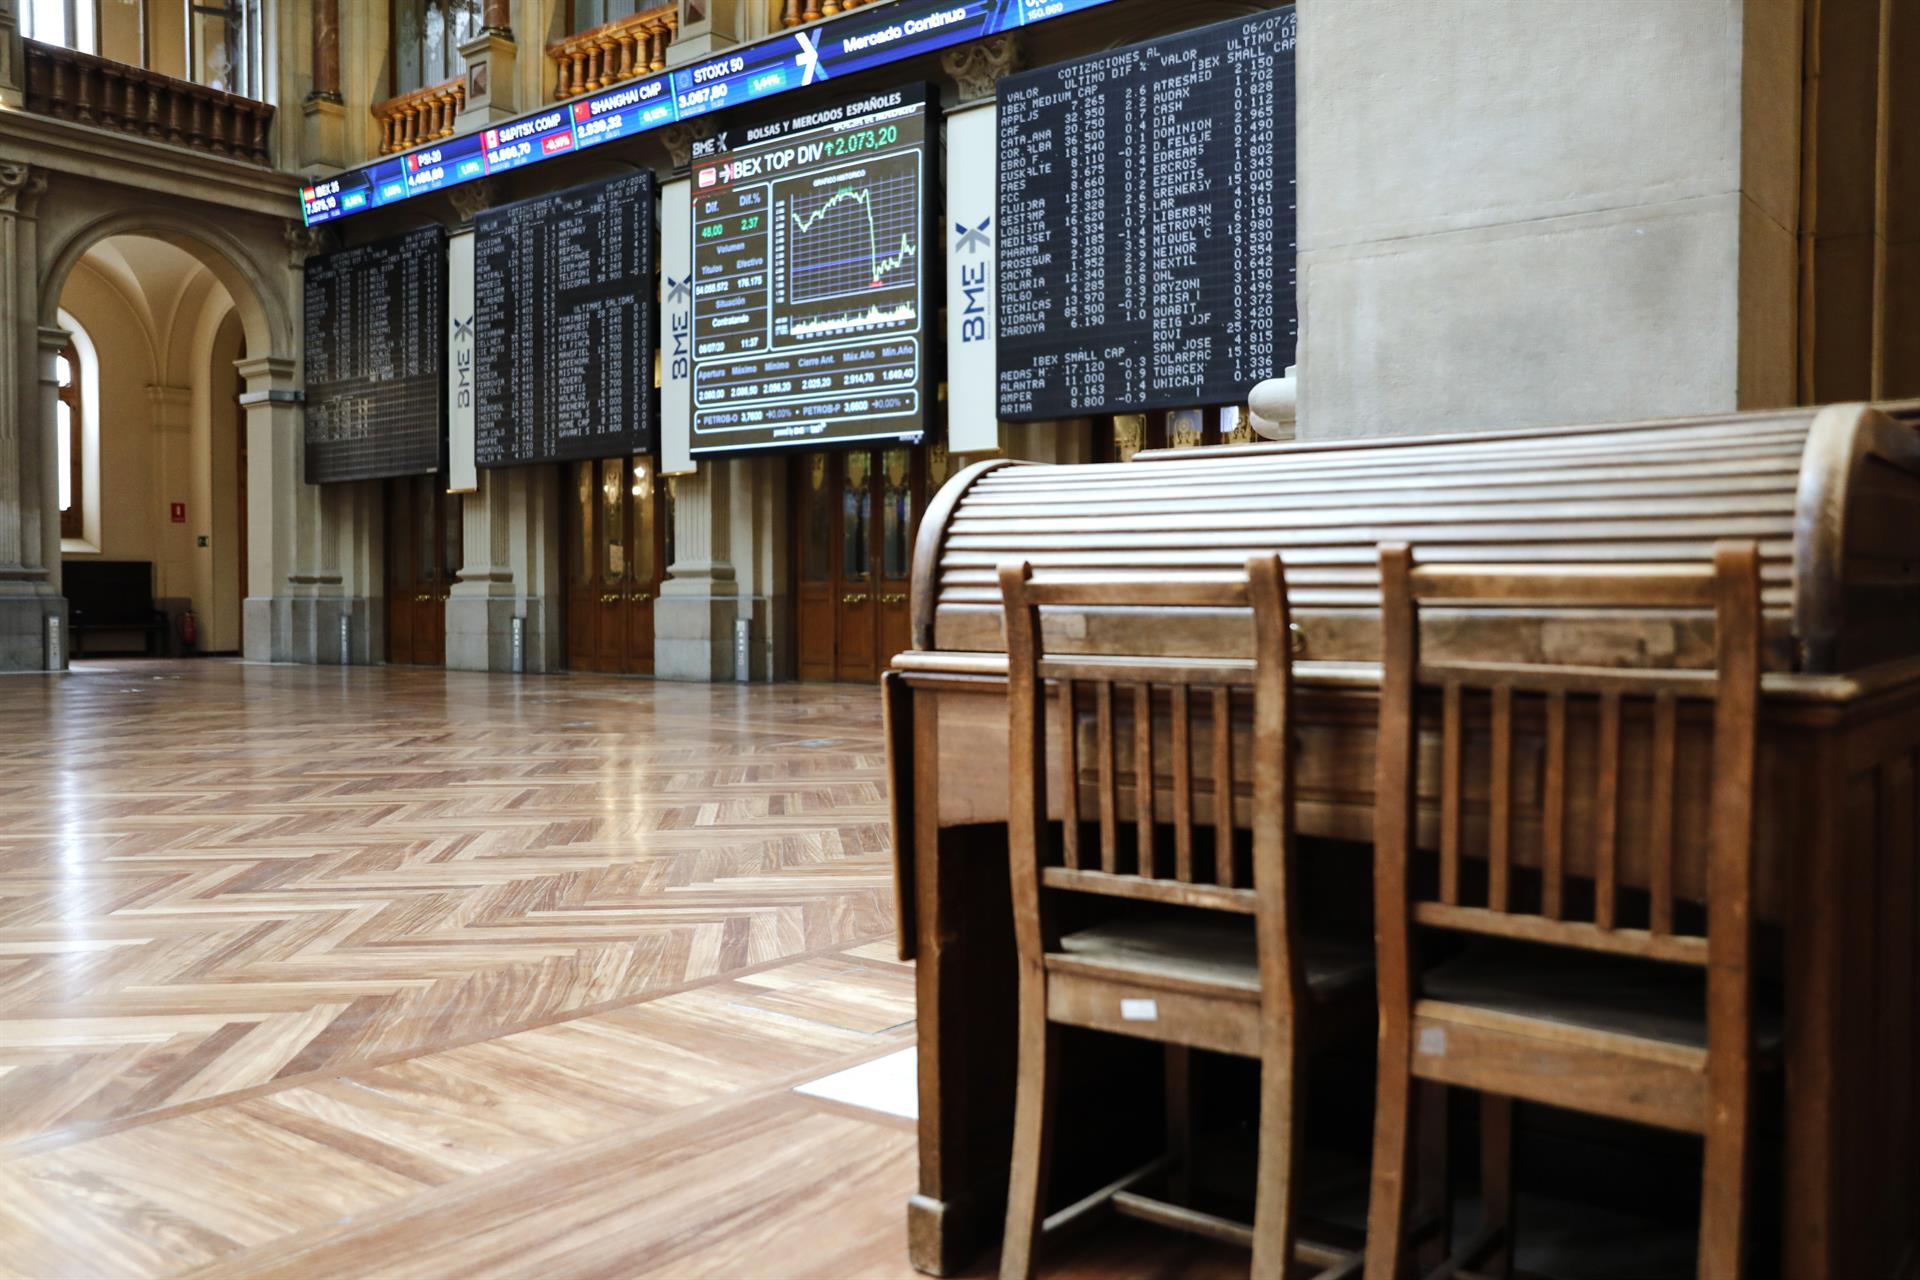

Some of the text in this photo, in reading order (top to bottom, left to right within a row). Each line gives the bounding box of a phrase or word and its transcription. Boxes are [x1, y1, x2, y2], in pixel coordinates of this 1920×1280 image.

[843, 8, 967, 54] Mercado Continuo
[1160, 50, 1196, 67] VALOR
[1227, 32, 1273, 52] ULTIMO
[1227, 39, 1296, 64] SMALL CAP
[693, 56, 744, 83] STOXX 50
[1058, 46, 1160, 79] COTIZACIONES AL
[1234, 57, 1273, 75] 2.150
[1007, 86, 1038, 102] VALOR
[1064, 71, 1104, 89] ULTIMO
[1111, 65, 1131, 78] DIF
[1153, 69, 1272, 104] AUDAX 1.702
[590, 81, 662, 115] SHANGHAI CMP
[1002, 84, 1097, 114] IBEX MEDIUM CAP
[1071, 94, 1104, 110] 7.265
[1153, 82, 1272, 116] CASH 0.828
[747, 123, 780, 141] BOLSAS
[783, 121, 789, 132] Y
[792, 107, 843, 130] MERCADOS
[846, 92, 902, 117] ESPAÑOLES
[1001, 106, 1104, 137] CAF 32.950
[1153, 94, 1272, 128] DIA 0.112
[534, 113, 561, 132] COMP
[1064, 117, 1104, 135] 20.750
[1153, 107, 1273, 140] DOMINION 2.965
[1234, 119, 1273, 136] 0.490
[692, 138, 715, 156] BME
[835, 125, 897, 156] 2.073,20
[1064, 129, 1104, 146] 36.500
[1234, 132, 1272, 149] 2.440
[764, 149, 795, 172] TOP
[797, 142, 824, 165] DIV
[1001, 156, 1025, 170] EBRO
[1065, 141, 1104, 157] 18.540
[1153, 144, 1272, 176] ERCROS 1.802
[1153, 157, 1272, 187] EZENTIS 0.343
[1228, 169, 1272, 186] 15.000
[1001, 179, 1025, 192] FAES
[705, 201, 720, 214] Dif.
[1000, 191, 1019, 203] FCC
[1153, 198, 1174, 211] LAR
[1234, 194, 1271, 210] 0.161
[741, 216, 759, 231] 2,37
[1234, 207, 1272, 222] 6.190
[1153, 219, 1272, 247] MIQUEL C 12.980
[716, 242, 745, 255] Volumen
[1001, 244, 1038, 259] PHARMA
[1153, 231, 1272, 259] NEINOR 9.530
[736, 257, 763, 270] Efectivo
[1001, 245, 1104, 270] PROSEGUR 2.230
[1153, 244, 1272, 270] NEXTIL 0.554
[1001, 268, 1032, 281] SACYR
[1153, 256, 1272, 282] OHL 0.642
[1234, 269, 1272, 284] 3.150
[1000, 277, 1044, 292] SOLARIA
[962, 262, 985, 343] BME
[1001, 290, 1032, 303] TALGO
[1001, 291, 1104, 314] TECNICAS 13.970
[1153, 292, 1189, 306] PRISA
[1153, 294, 1272, 318] QUABIT 0.372
[712, 314, 750, 328] Contratando
[1001, 311, 1044, 325] VIDRALA
[1153, 306, 1272, 330] REIG 3.420
[1000, 322, 1044, 336] ZARDOYA
[1153, 319, 1272, 342] ROVI 25.700
[672, 311, 688, 380] BME
[1153, 331, 1272, 353] SAN JOSE 4.815
[1033, 347, 1124, 366] IBEX SMALL CAP
[1153, 344, 1272, 365] SOLARPAC 15.500
[1065, 361, 1104, 374] 17.120
[1153, 356, 1272, 377] TUBACEX 1.336
[1234, 368, 1272, 382] 0.495
[458, 349, 471, 409] BME
[1001, 373, 1104, 392] ALANTRA 11.000
